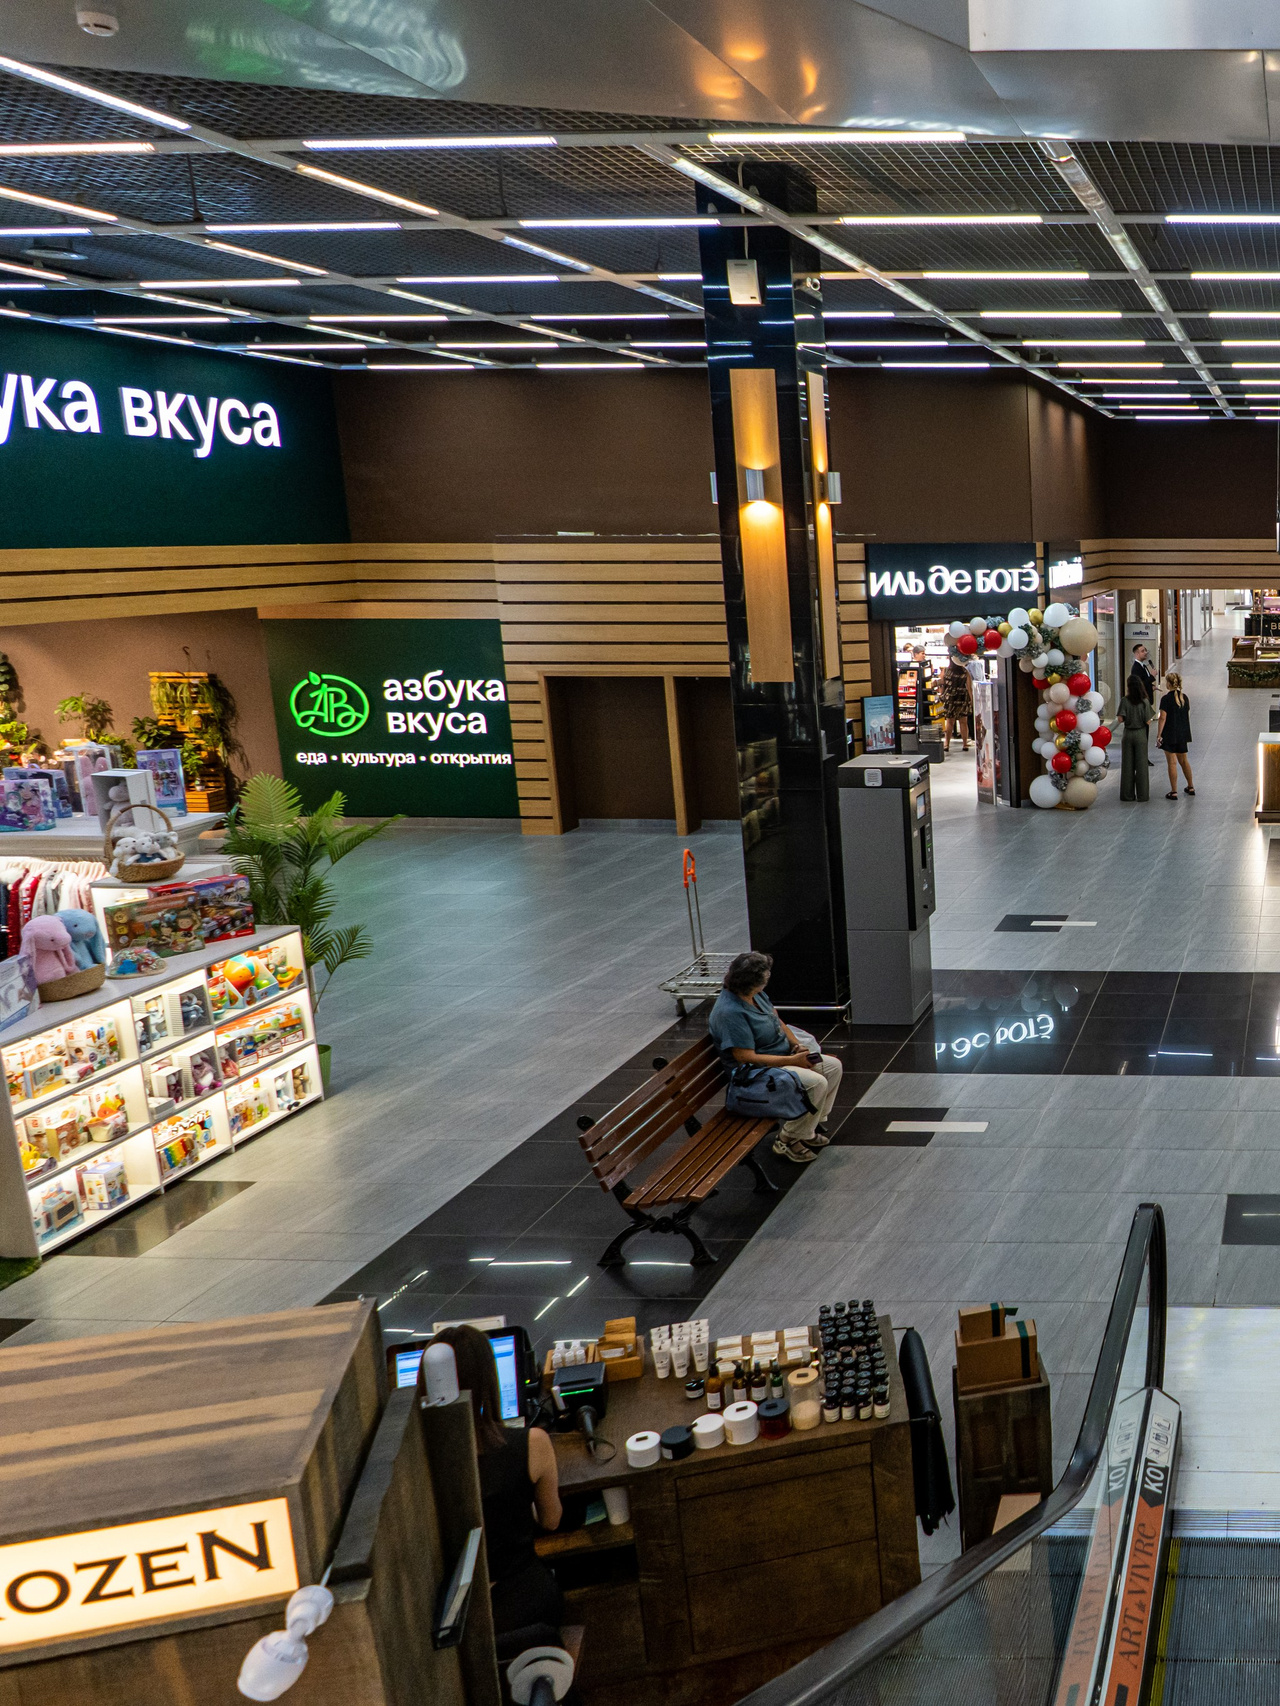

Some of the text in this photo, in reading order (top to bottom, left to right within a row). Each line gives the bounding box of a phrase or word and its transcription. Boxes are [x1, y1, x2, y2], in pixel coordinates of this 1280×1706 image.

[118, 386, 282, 458] вкуса
[869, 570, 926, 597] ИЛЬ
[382, 669, 506, 708] азбука
[386, 711, 488, 741] вкуса
[296, 752, 513, 768] еда культура открытия
[0, 1520, 275, 1621] OZEN
[1118, 1607, 1145, 1669] ART
